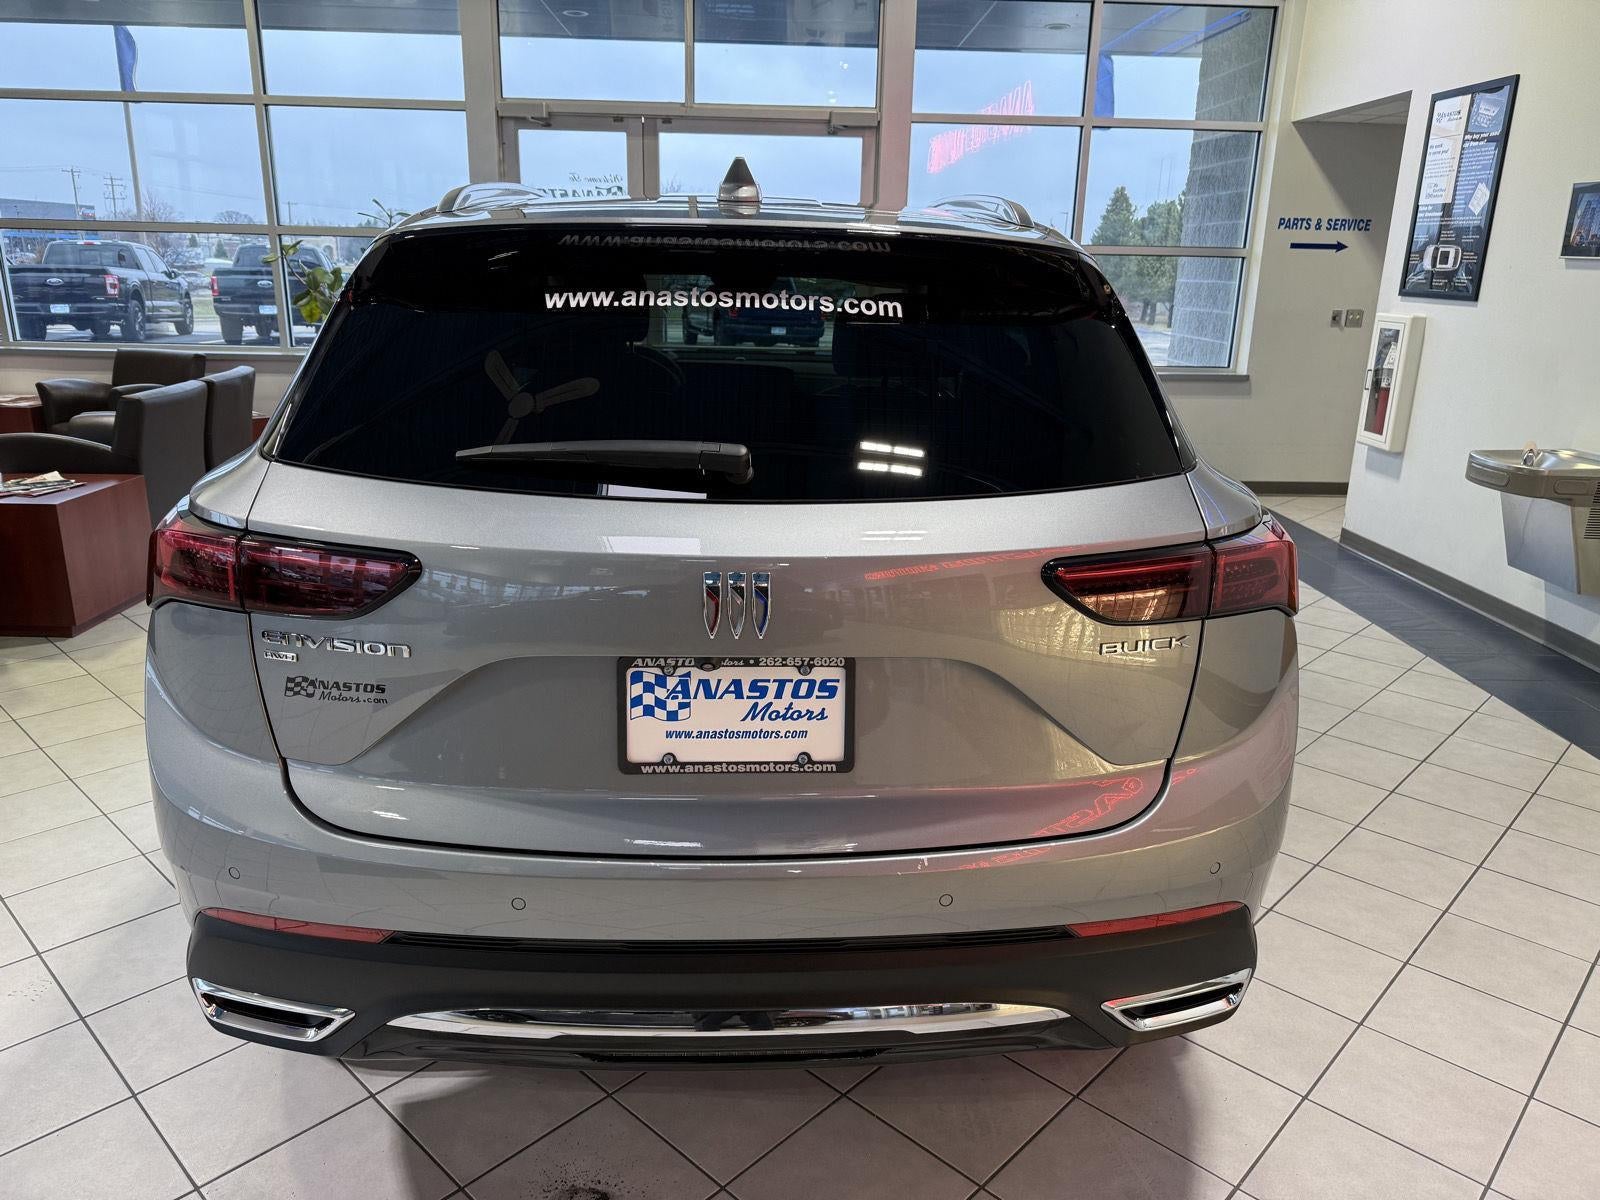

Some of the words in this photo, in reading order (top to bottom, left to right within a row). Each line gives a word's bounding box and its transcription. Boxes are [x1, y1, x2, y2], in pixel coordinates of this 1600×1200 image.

[1278, 218, 1312, 230] PARTS
[1315, 218, 1322, 230] &
[1326, 219, 1372, 231] SERVICE
[545, 286, 903, 318] www.anastosmotors.com
[1099, 634, 1191, 656] BUICK
[631, 657, 695, 668] ANASTO
[758, 656, 846, 667] 262-657-6020
[306, 676, 387, 694] ANASTOS
[664, 678, 841, 701] ANASTOS
[740, 701, 829, 723] Motors
[665, 728, 809, 740] www.anastosmotors.com
[640, 761, 838, 774] www.anastosmotors.com
